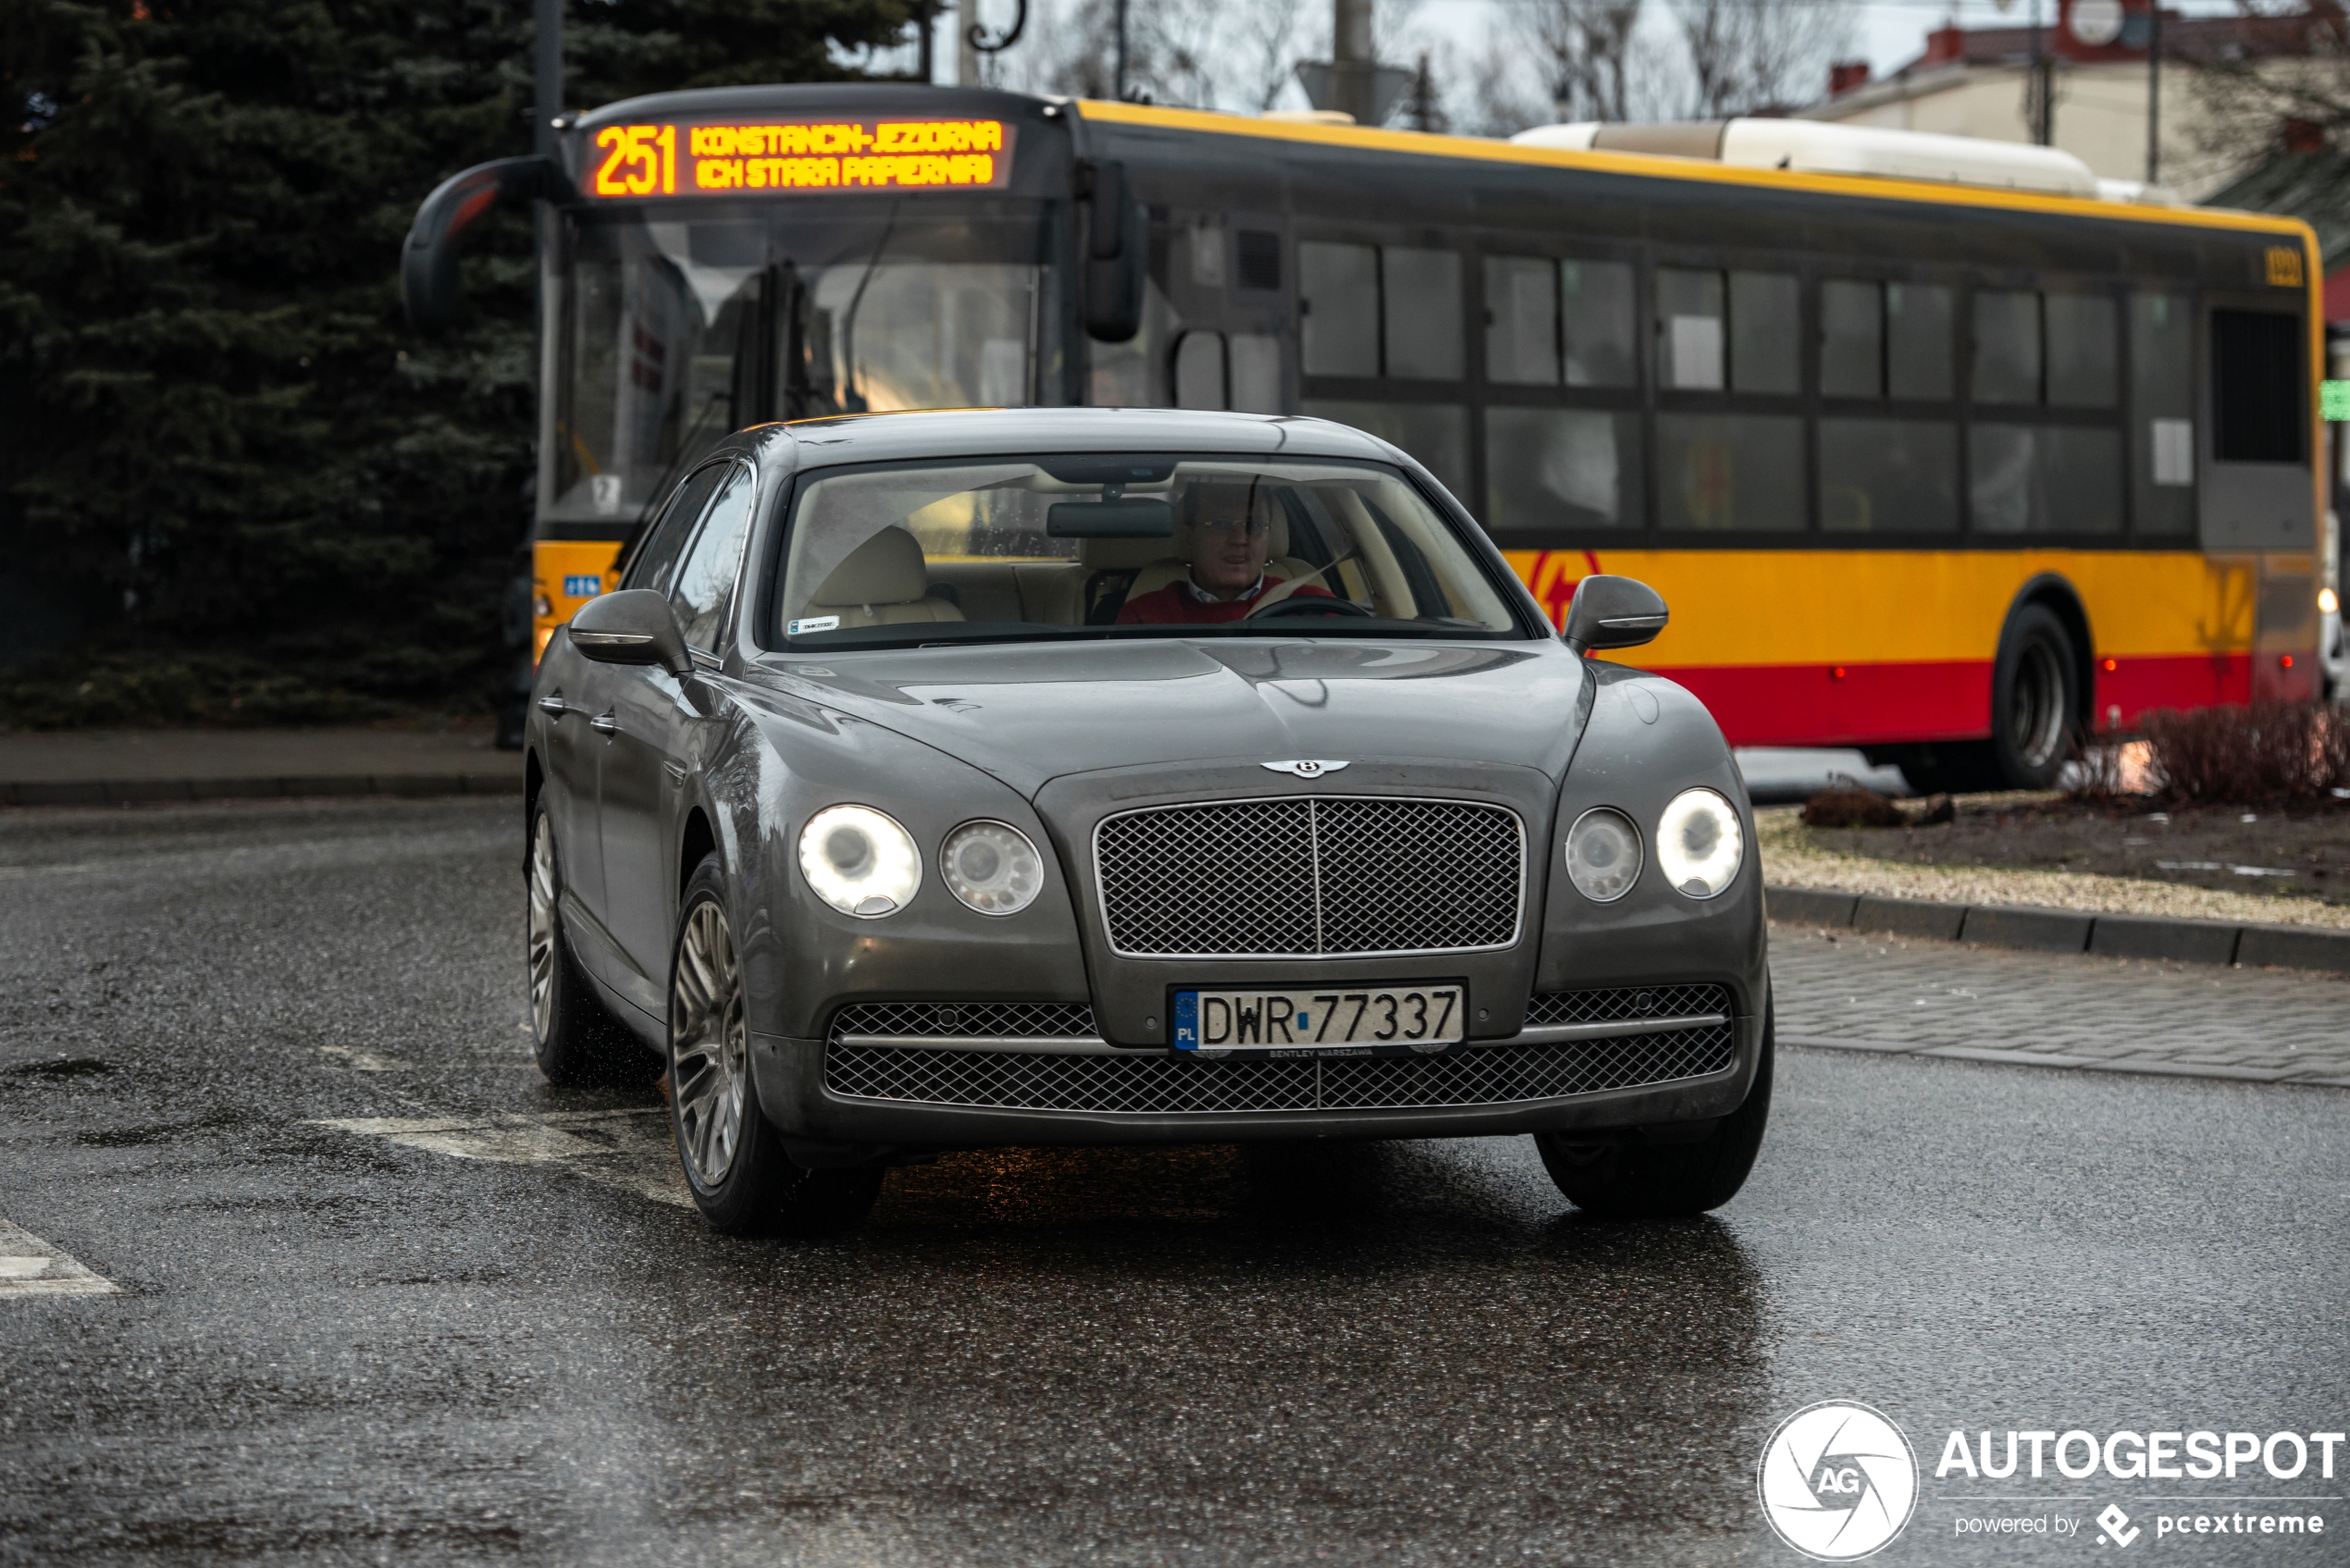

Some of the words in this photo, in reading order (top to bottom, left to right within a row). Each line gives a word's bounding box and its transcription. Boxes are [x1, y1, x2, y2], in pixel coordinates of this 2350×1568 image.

[597, 125, 675, 194] 251
[746, 156, 839, 188] STARA
[1204, 995, 1293, 1044] DWR
[1314, 992, 1457, 1043] 77337
[1178, 1028, 1195, 1041] PL
[1269, 1050, 1315, 1058] BENTLEY
[1317, 1048, 1374, 1057] WARSZAWA
